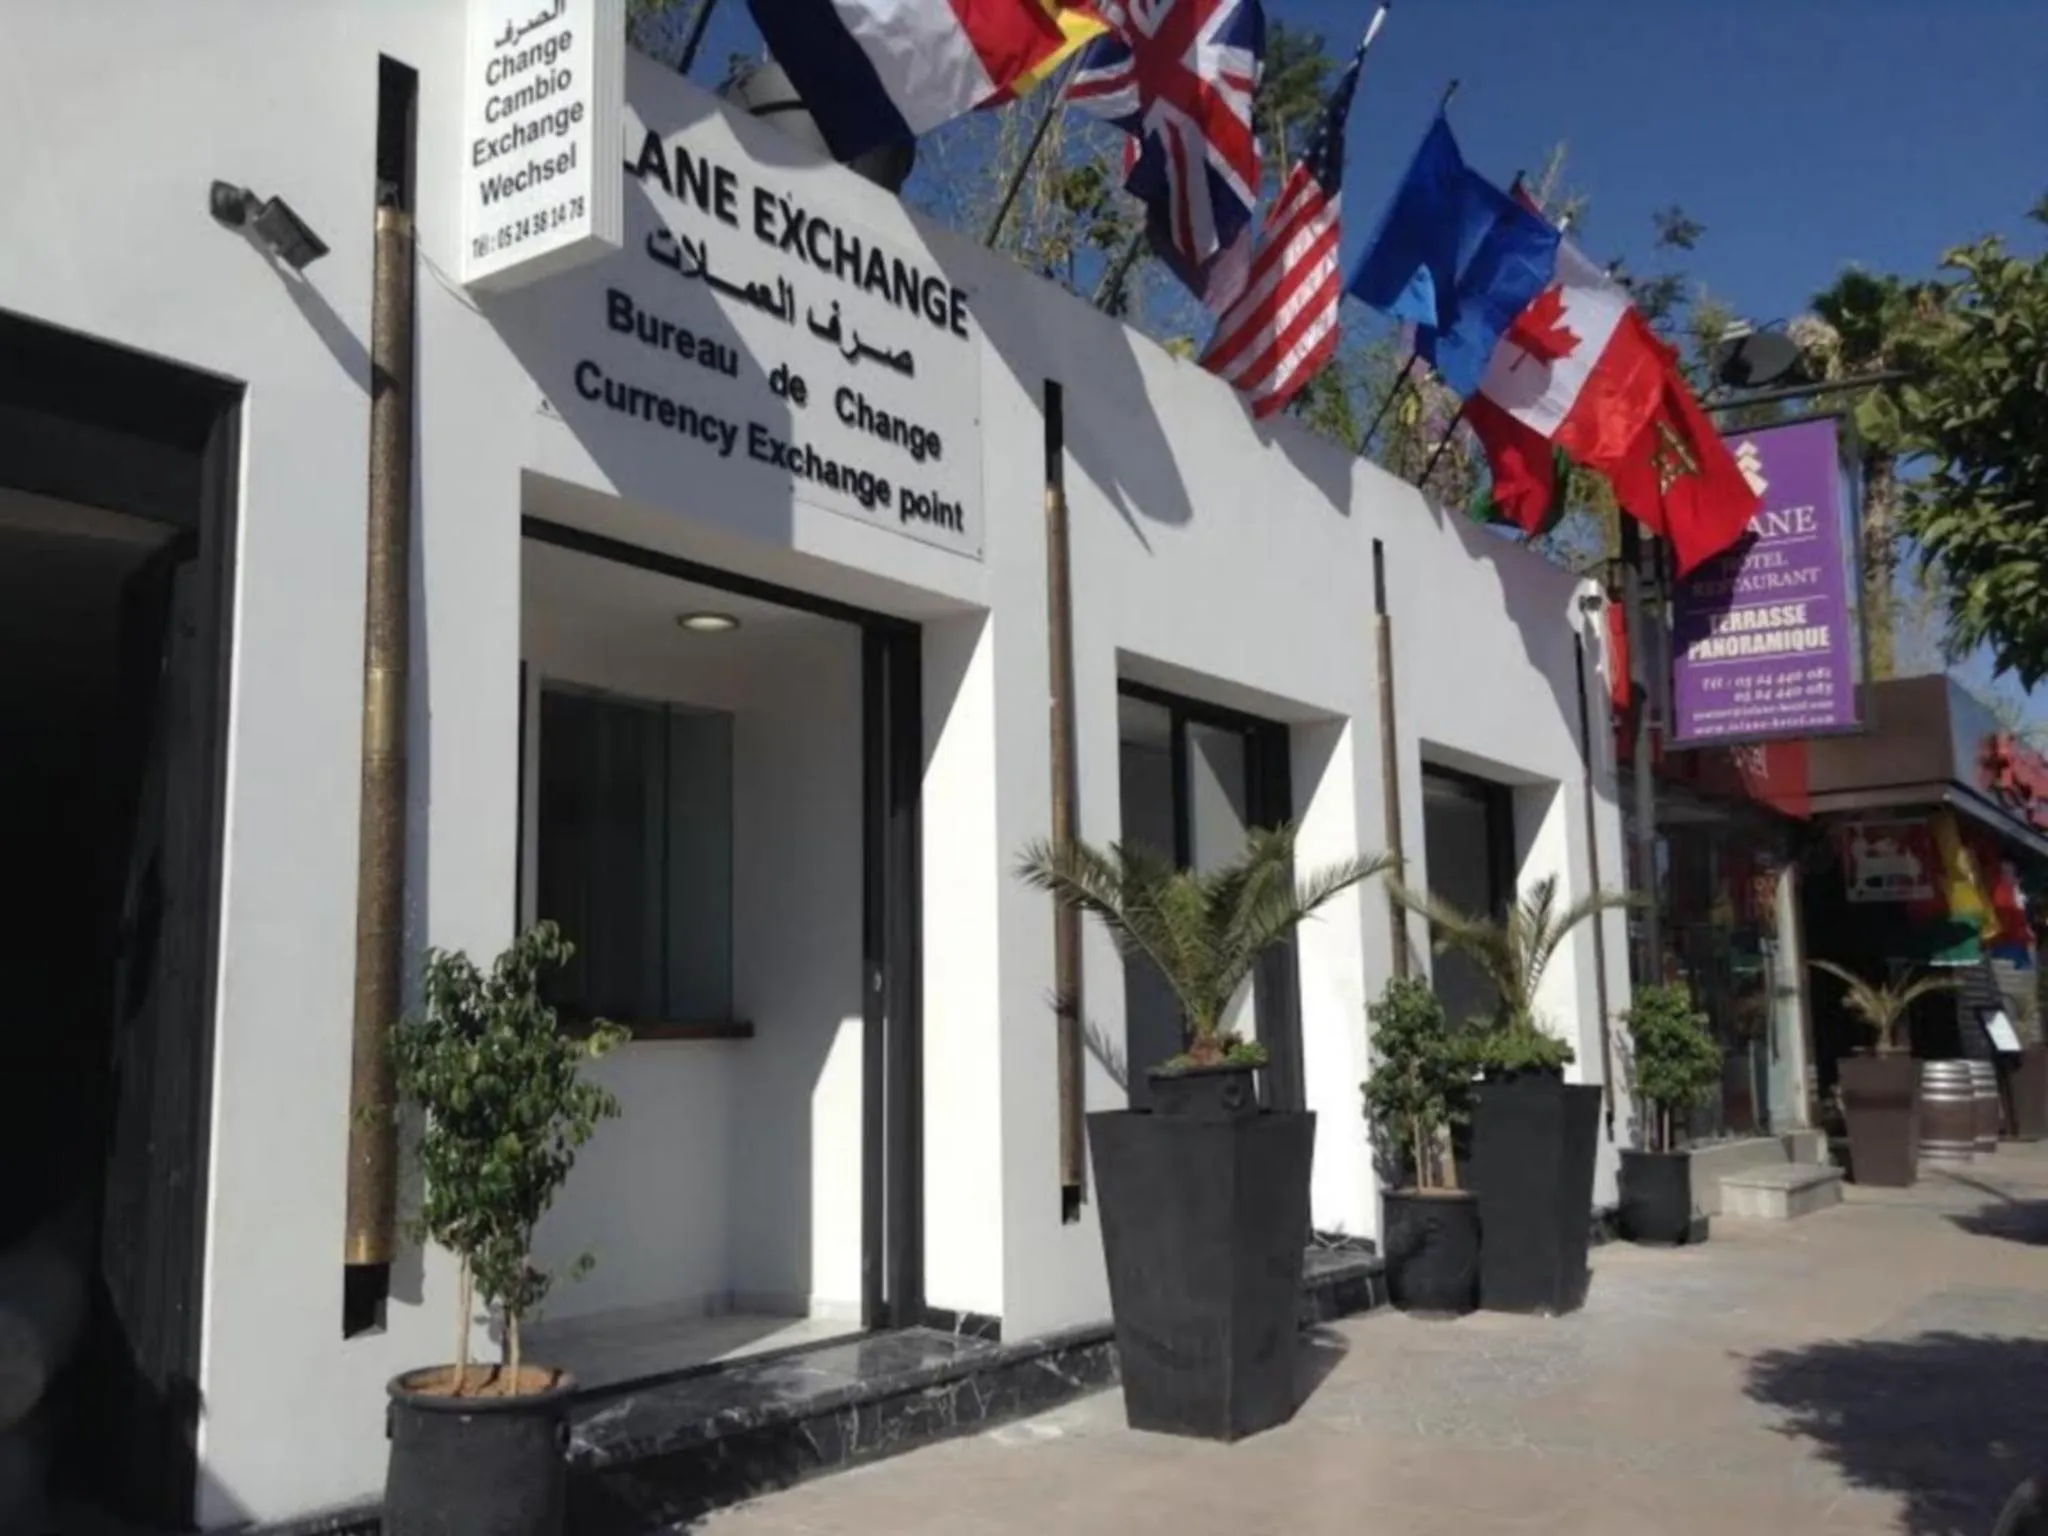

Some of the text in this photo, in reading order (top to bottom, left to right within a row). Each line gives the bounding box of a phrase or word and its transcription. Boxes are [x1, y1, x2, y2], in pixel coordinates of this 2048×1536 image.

[485, 30, 573, 87] Change
[485, 67, 572, 124] Cambio
[472, 101, 584, 168] Exchange
[479, 141, 577, 206] Wechsel
[753, 184, 969, 339] EXCHANGE
[646, 227, 914, 376] صرف العملات
[606, 288, 941, 462] Bureau de Change
[574, 360, 964, 531] Currency Exchange point
[1688, 625, 1830, 661] PANORAMIQUE
[1710, 603, 1807, 635] TERRASSE
